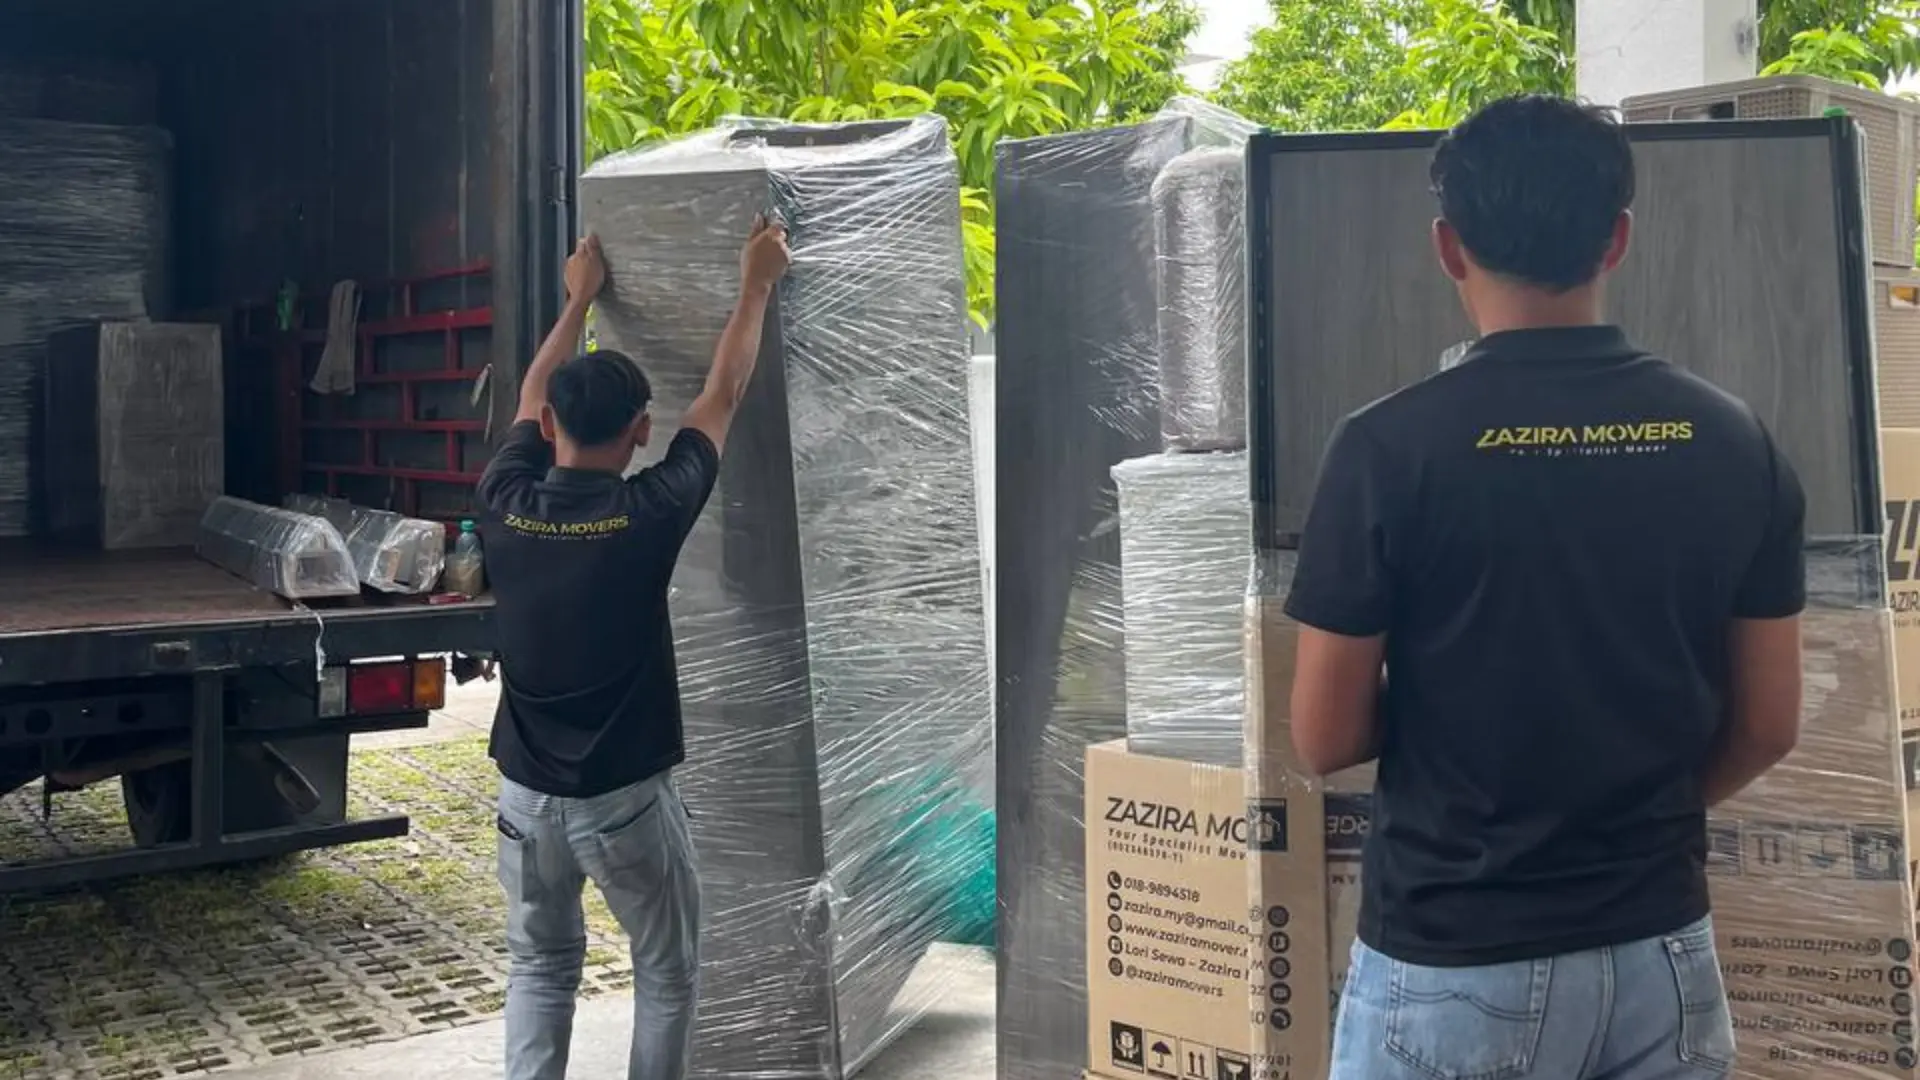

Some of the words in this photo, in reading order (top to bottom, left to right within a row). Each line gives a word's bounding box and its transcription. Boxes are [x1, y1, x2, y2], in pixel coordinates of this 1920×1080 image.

[1476, 427, 1578, 448] ZAZIRA
[1583, 421, 1693, 443] MOVERS
[504, 513, 558, 534] ZAZIRA
[559, 515, 629, 534] MOVERS
[1105, 797, 1199, 837] ZAZIRA
[1108, 827, 1137, 841] Your
[1142, 832, 1211, 855] Specialist
[1125, 943, 1149, 958] Lori
[1151, 949, 1185, 967] Sewa
[1199, 959, 1241, 979] Zazira
[1126, 965, 1224, 997] @zaziramovers
